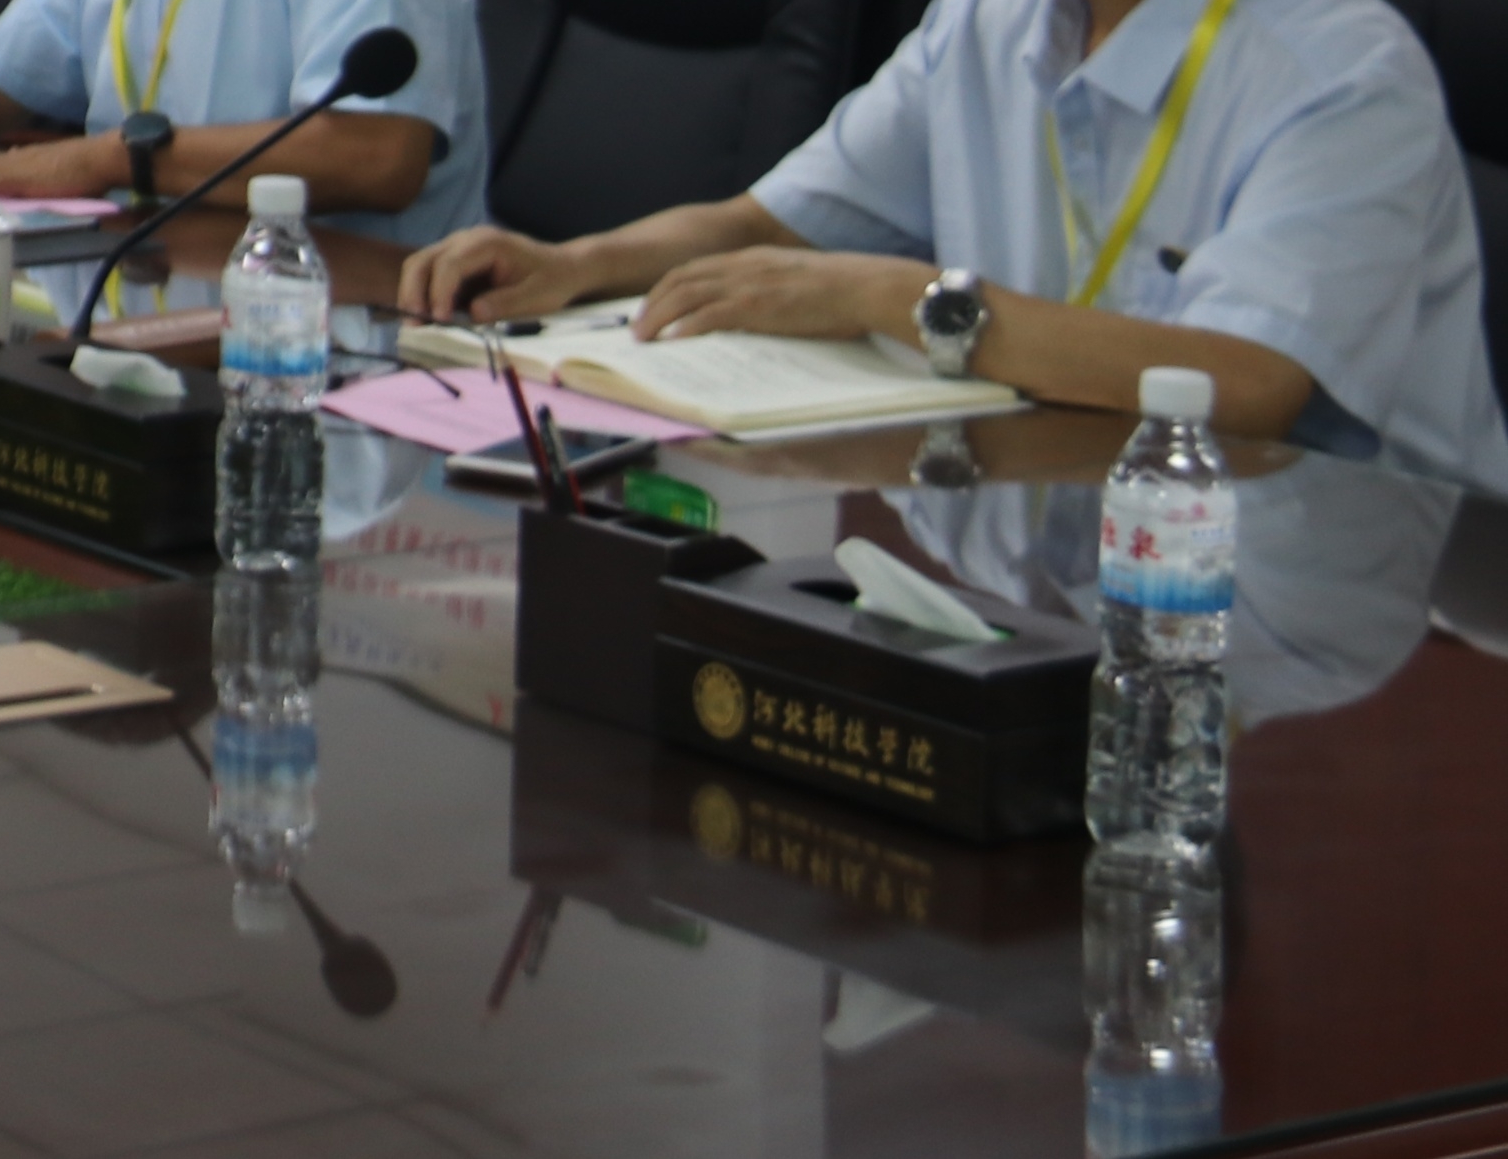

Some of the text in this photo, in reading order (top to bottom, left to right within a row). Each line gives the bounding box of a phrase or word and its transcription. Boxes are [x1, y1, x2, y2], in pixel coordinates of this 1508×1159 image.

[753, 690, 935, 776] 河北科技学院
